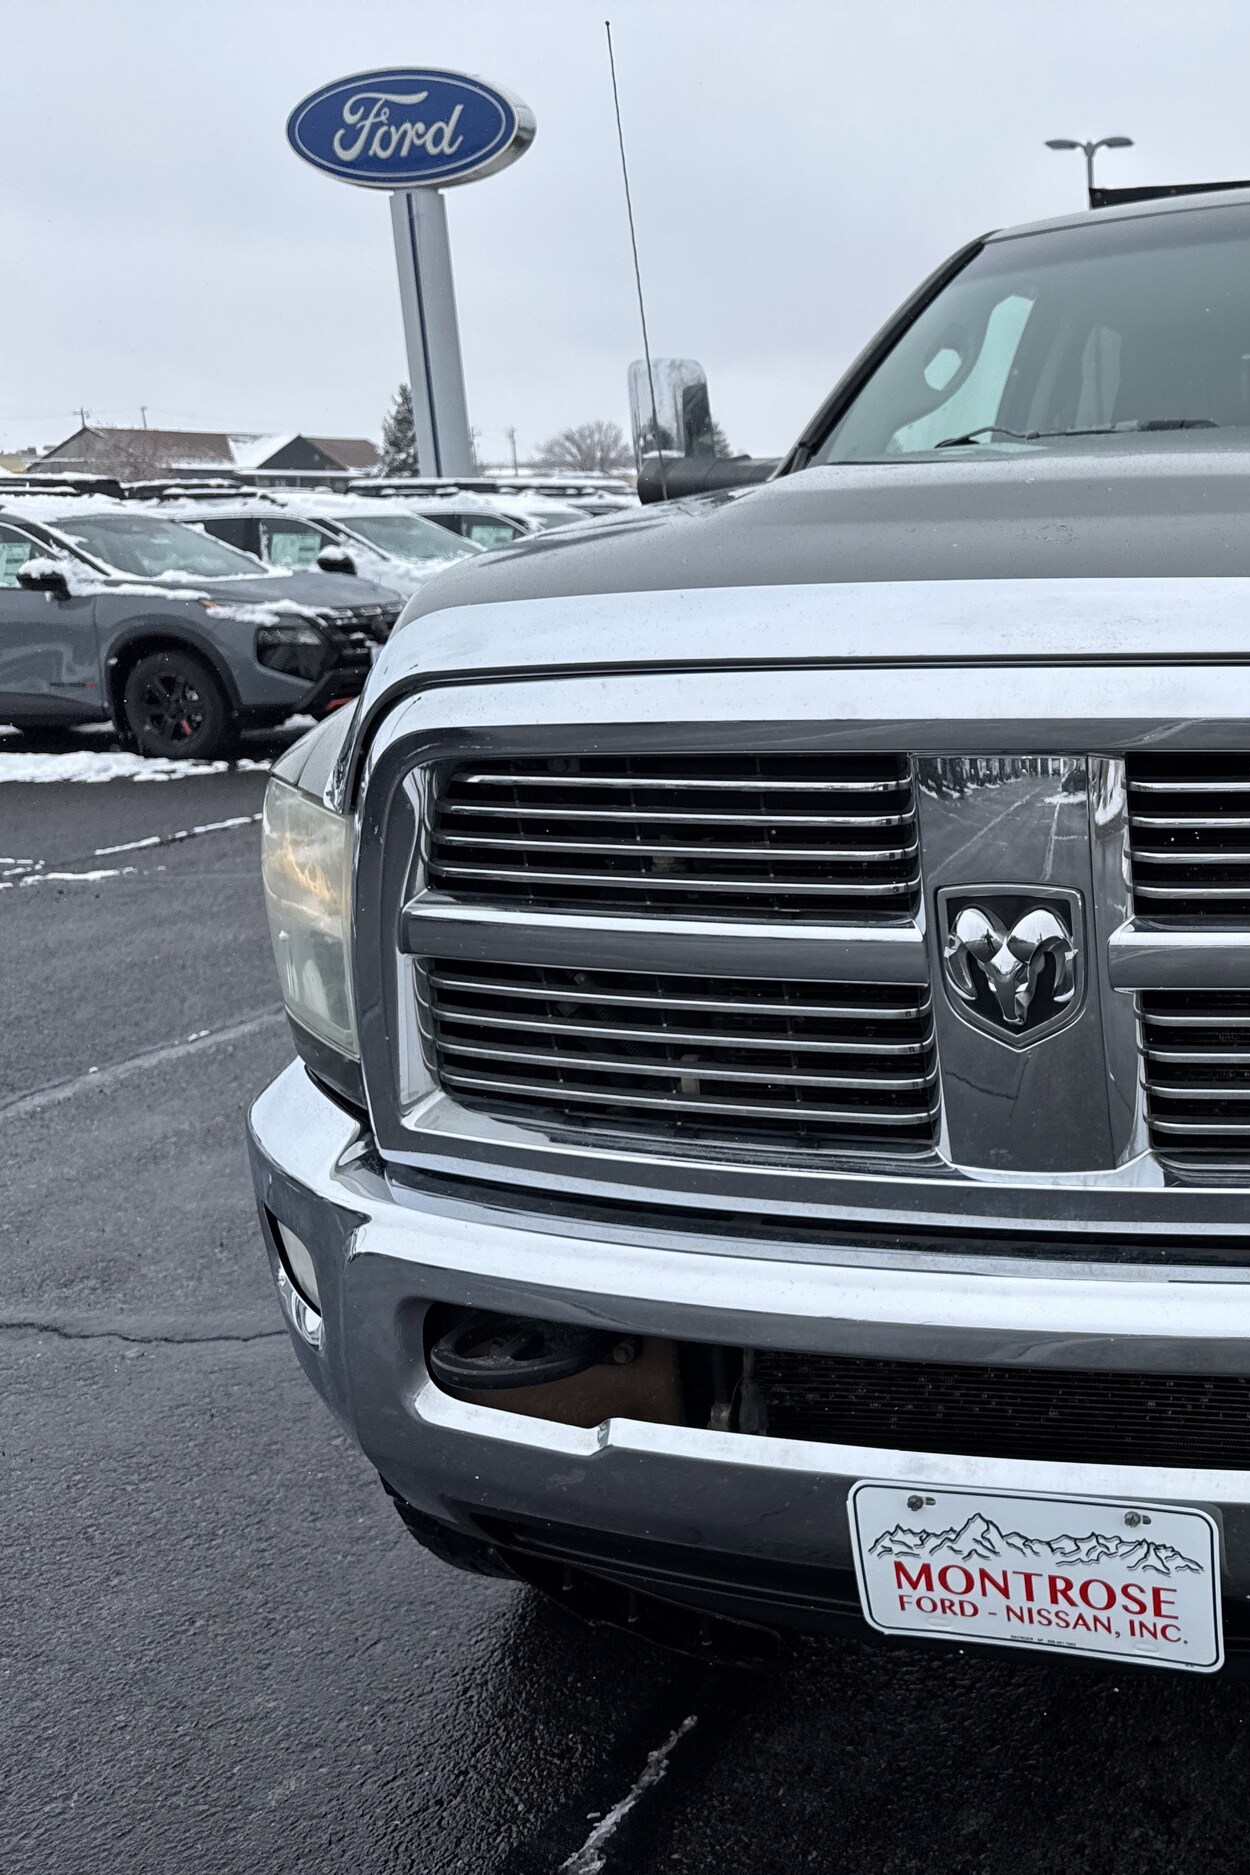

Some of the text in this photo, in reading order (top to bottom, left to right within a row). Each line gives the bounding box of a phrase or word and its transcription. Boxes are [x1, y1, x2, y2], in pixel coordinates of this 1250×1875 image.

[333, 91, 464, 162] Ford
[894, 1560, 1179, 1620] MONTROSE
[898, 1594, 979, 1618] FORD
[1005, 1604, 1121, 1639] NISSAN,
[1128, 1618, 1188, 1645] INC.
